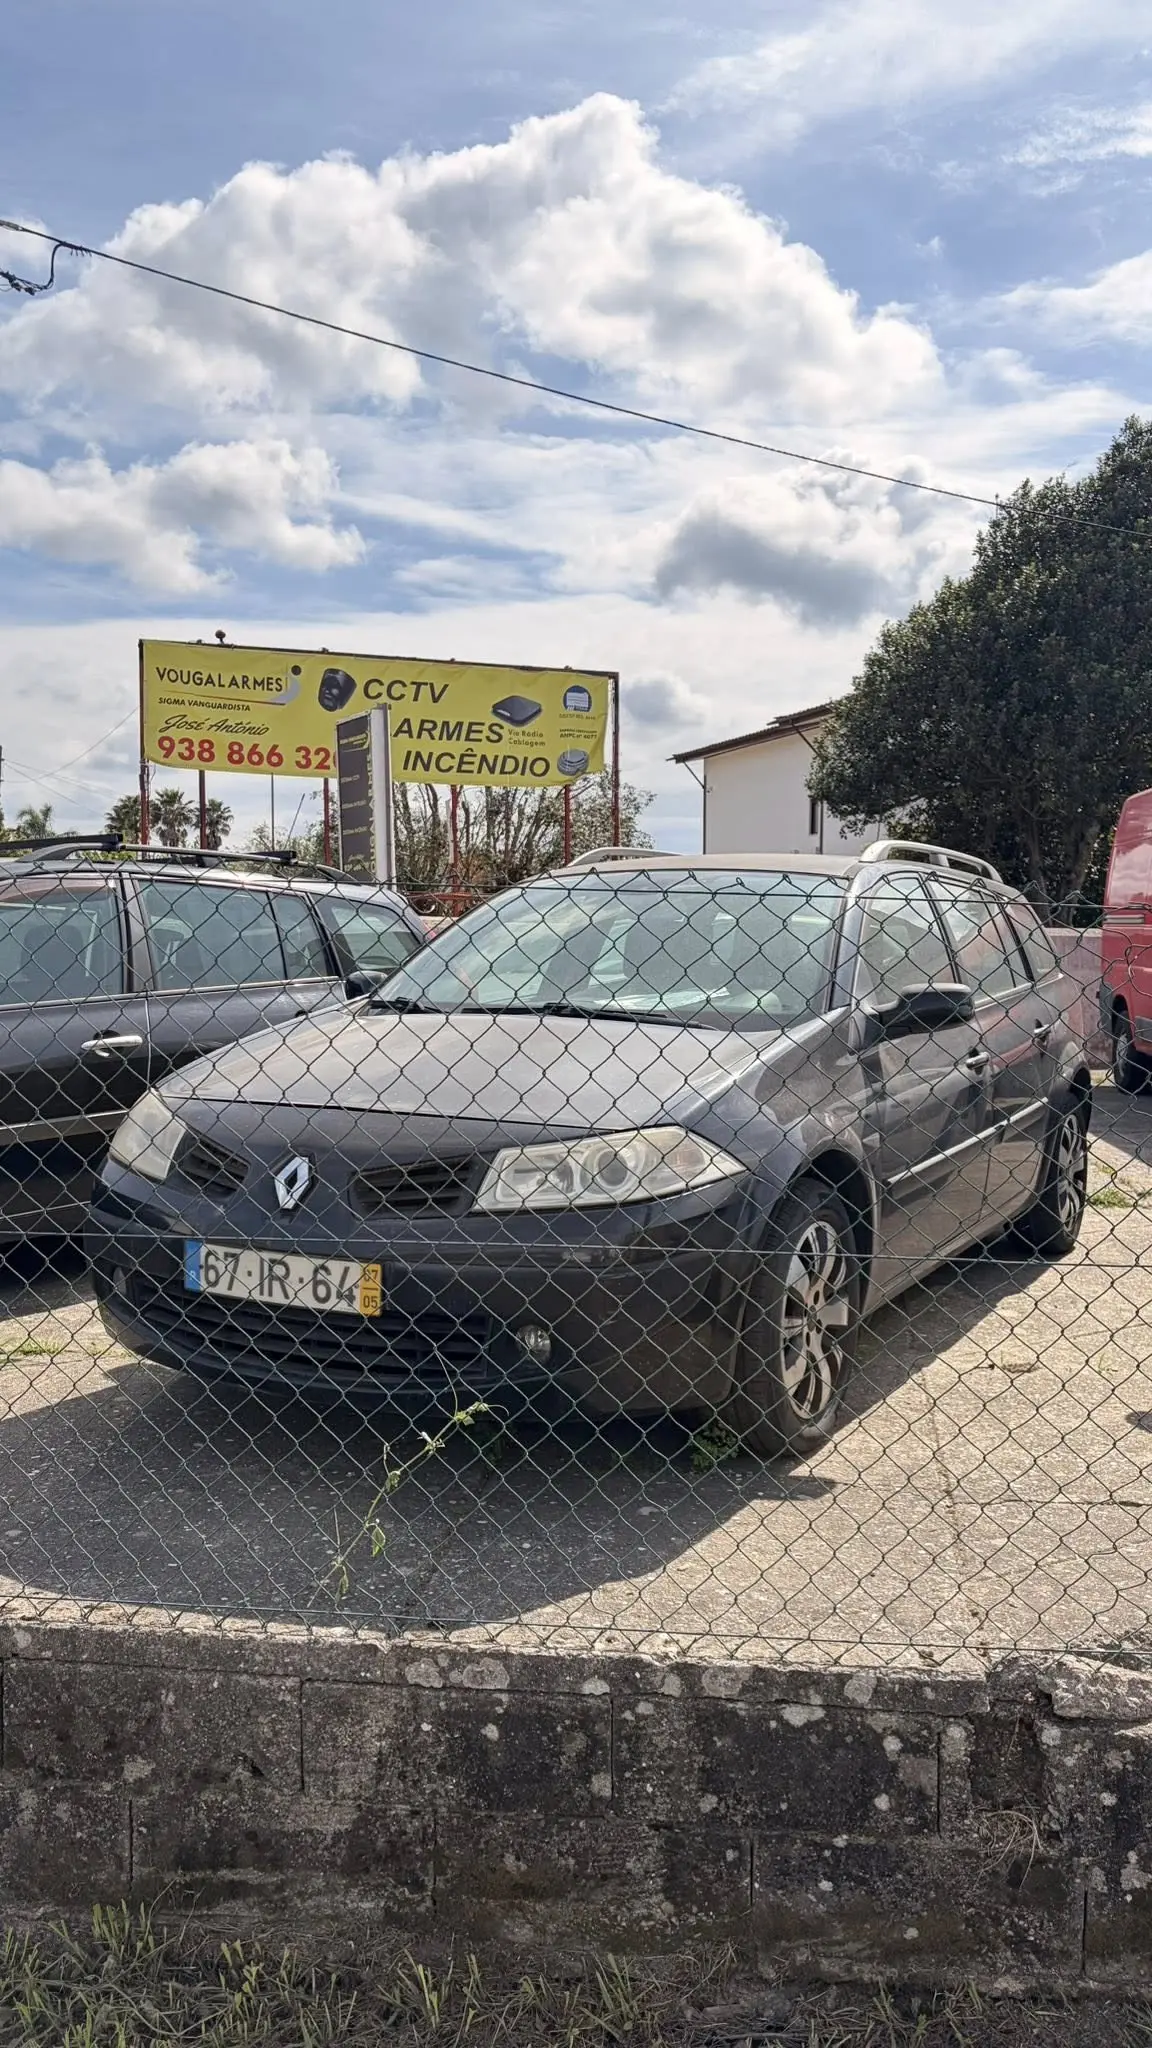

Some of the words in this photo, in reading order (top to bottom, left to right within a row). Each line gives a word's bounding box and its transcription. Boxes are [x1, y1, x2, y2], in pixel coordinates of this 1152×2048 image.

[156, 667, 283, 692] VOUGALARMES
[363, 678, 449, 703] CCTV
[158, 697, 186, 707] SIGMA
[188, 699, 251, 712] VANGUARDISTA
[159, 714, 207, 734] José
[208, 717, 270, 736] António
[389, 717, 504, 744] ARMES
[157, 736, 216, 763] 938
[227, 741, 284, 768] 866
[295, 746, 337, 771] 32
[403, 747, 550, 777] INCÊNDIO
[363, 1295, 378, 1309] 05
